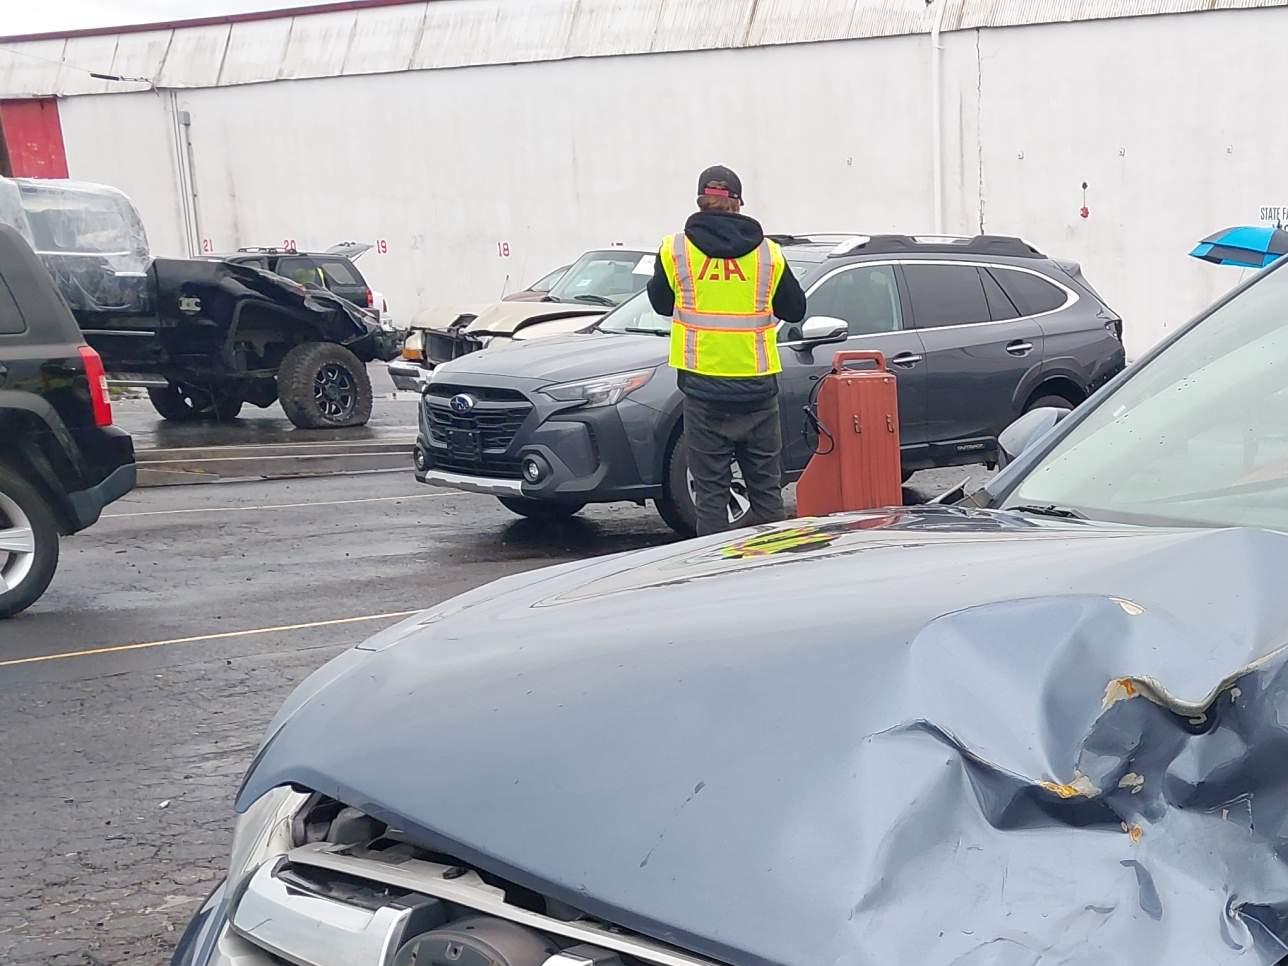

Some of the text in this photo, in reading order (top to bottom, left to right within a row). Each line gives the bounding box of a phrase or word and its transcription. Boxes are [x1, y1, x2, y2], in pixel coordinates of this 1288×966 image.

[1260, 207, 1281, 221] STATE
[203, 239, 213, 253] 21
[376, 239, 388, 254] 19
[497, 241, 510, 257] 18
